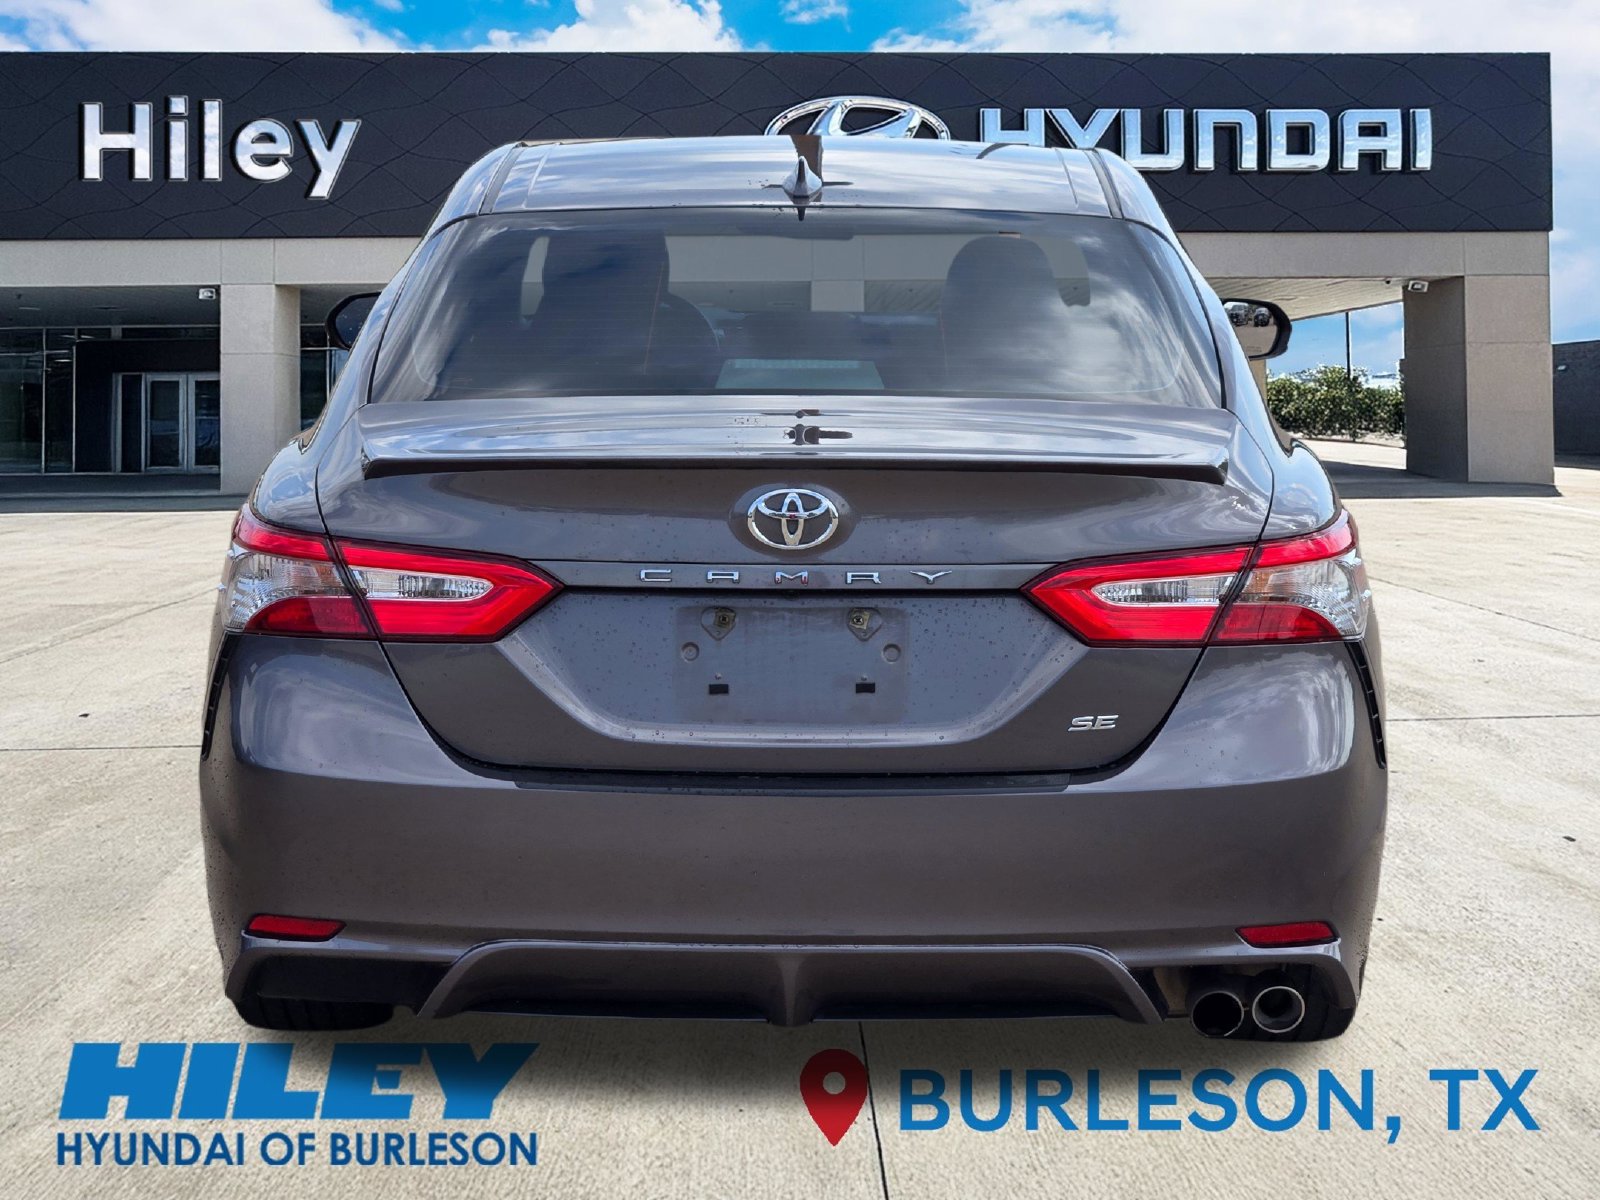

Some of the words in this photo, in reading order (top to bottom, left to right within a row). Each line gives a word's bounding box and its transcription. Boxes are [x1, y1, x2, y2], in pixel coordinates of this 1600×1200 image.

[80, 95, 362, 199] Hiley
[980, 108, 1433, 171] HYUNDAI
[640, 569, 952, 586] CAMRY
[1068, 715, 1119, 732] SE
